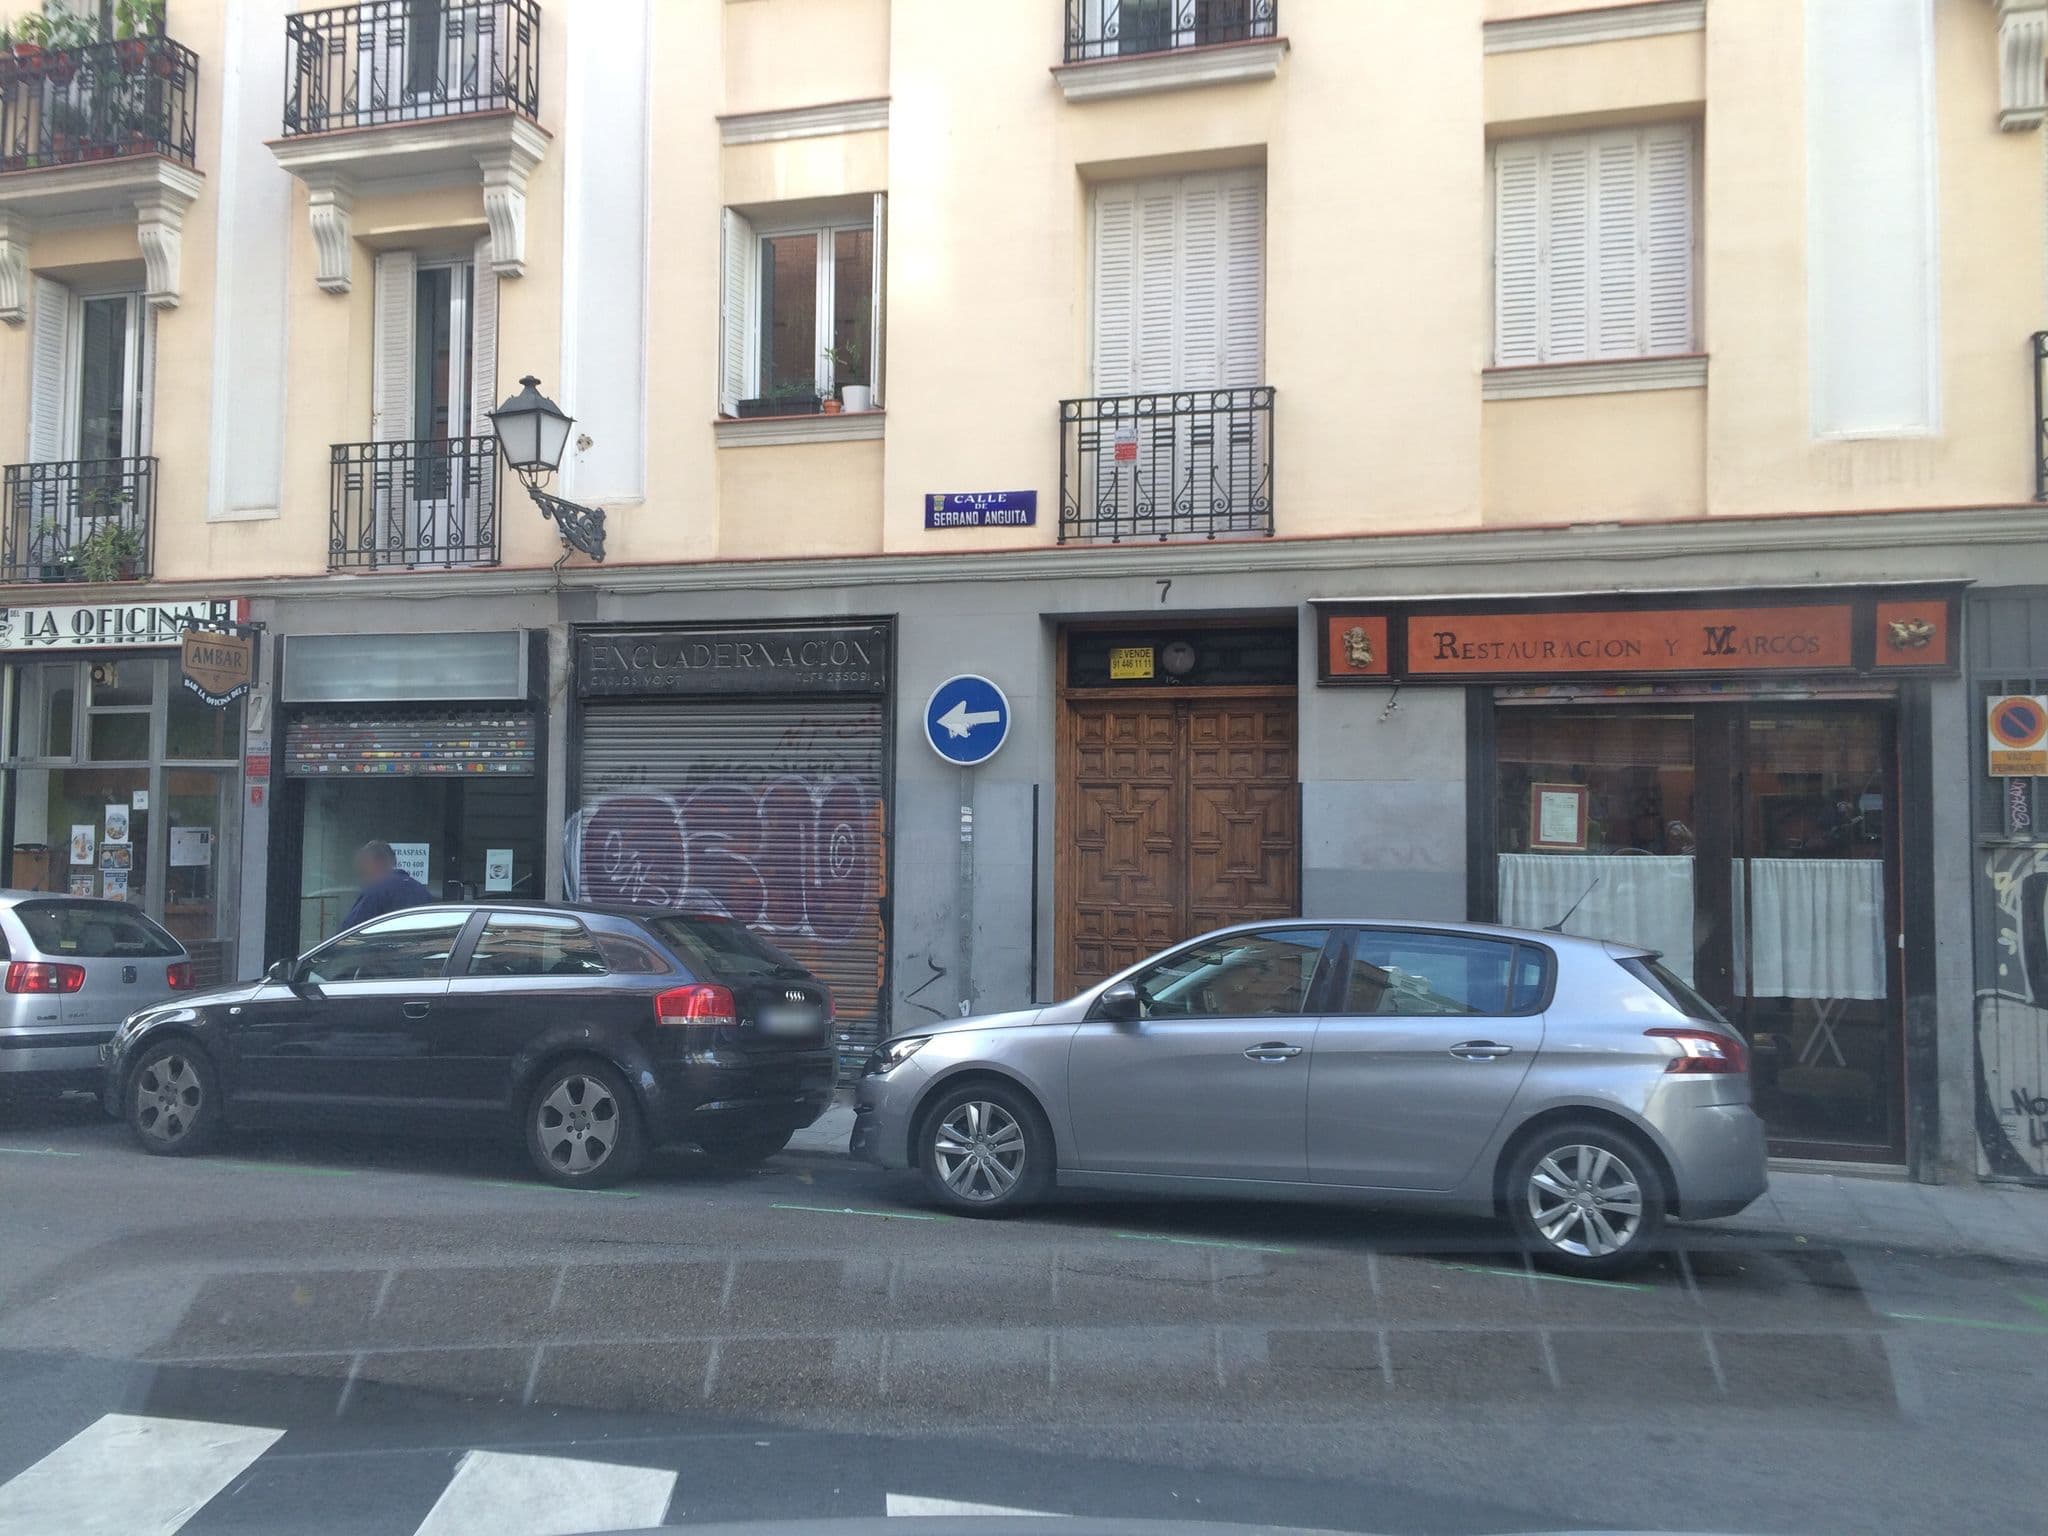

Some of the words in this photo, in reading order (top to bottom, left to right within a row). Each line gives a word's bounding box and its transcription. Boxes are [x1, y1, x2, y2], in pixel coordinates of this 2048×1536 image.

[954, 494, 1008, 503] CALLE
[933, 511, 979, 526] SERRANO
[984, 510, 1028, 525] ANGUITA
[1156, 579, 1172, 603] 7
[24, 611, 59, 637] LA
[71, 605, 195, 637] OFICINA
[1124, 649, 1151, 658] VENDE
[1664, 639, 1680, 656] Y
[192, 646, 242, 668] AMBAR
[1112, 661, 1120, 670] 91
[1136, 660, 1142, 668] 11
